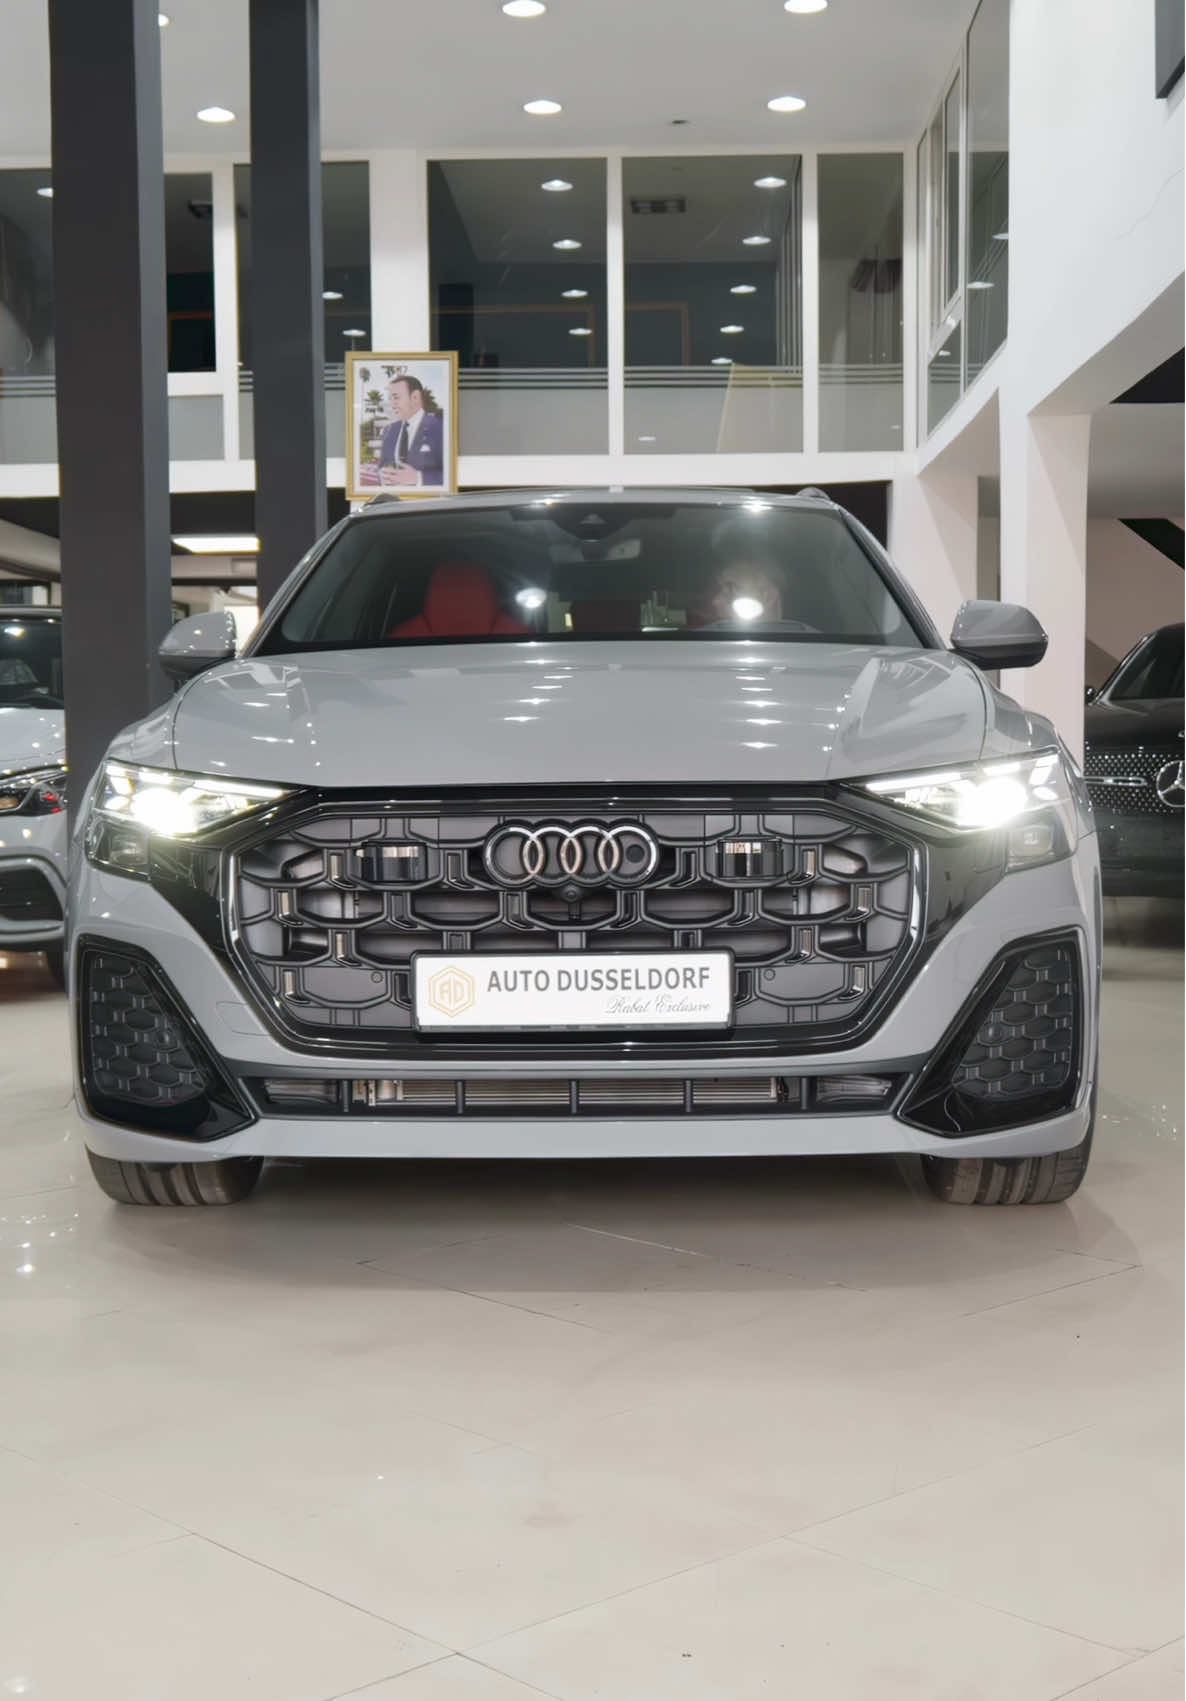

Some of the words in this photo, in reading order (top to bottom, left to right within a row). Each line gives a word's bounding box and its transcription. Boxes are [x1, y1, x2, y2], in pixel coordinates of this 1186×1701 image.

[487, 969, 550, 992] AUTO
[558, 966, 710, 991] DUSSELDORF
[655, 993, 711, 1013] Exclusive
